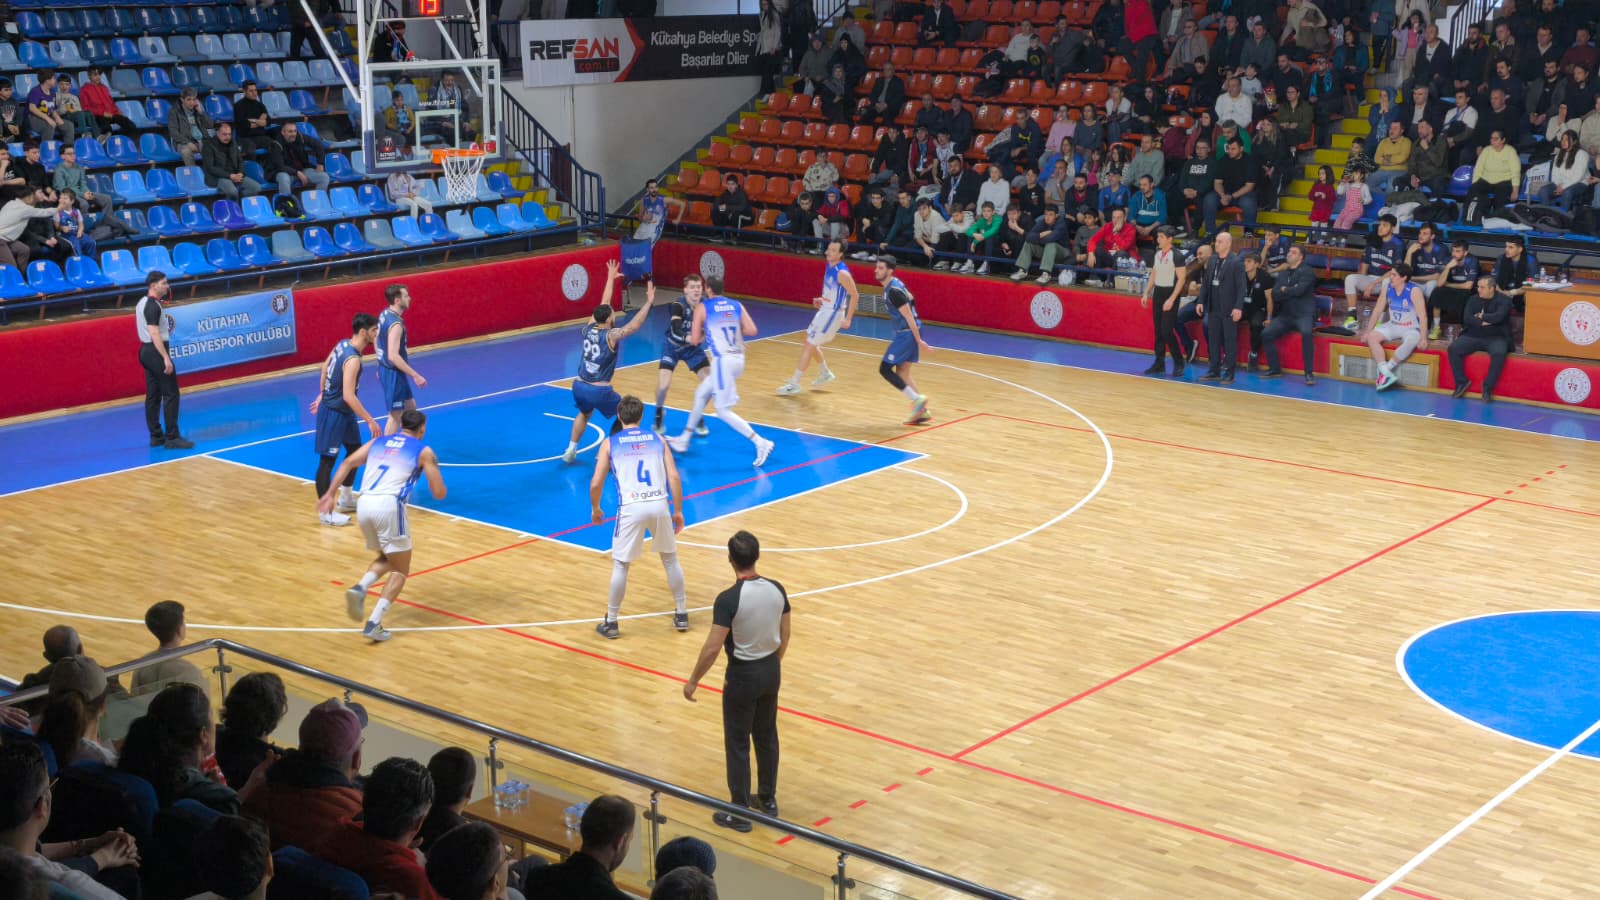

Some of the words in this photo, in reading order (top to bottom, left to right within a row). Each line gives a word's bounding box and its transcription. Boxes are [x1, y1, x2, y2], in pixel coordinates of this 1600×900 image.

[529, 37, 619, 60] REFSAN
[650, 31, 696, 48] Kütahya
[698, 30, 740, 47] Belediye
[727, 51, 749, 65] Diler
[197, 312, 250, 333] KÜTAHYA
[245, 324, 291, 345] KULÜBÜ
[721, 326, 737, 347] 17
[584, 339, 601, 361] 99
[369, 464, 390, 490] 7
[637, 459, 653, 487] 4
